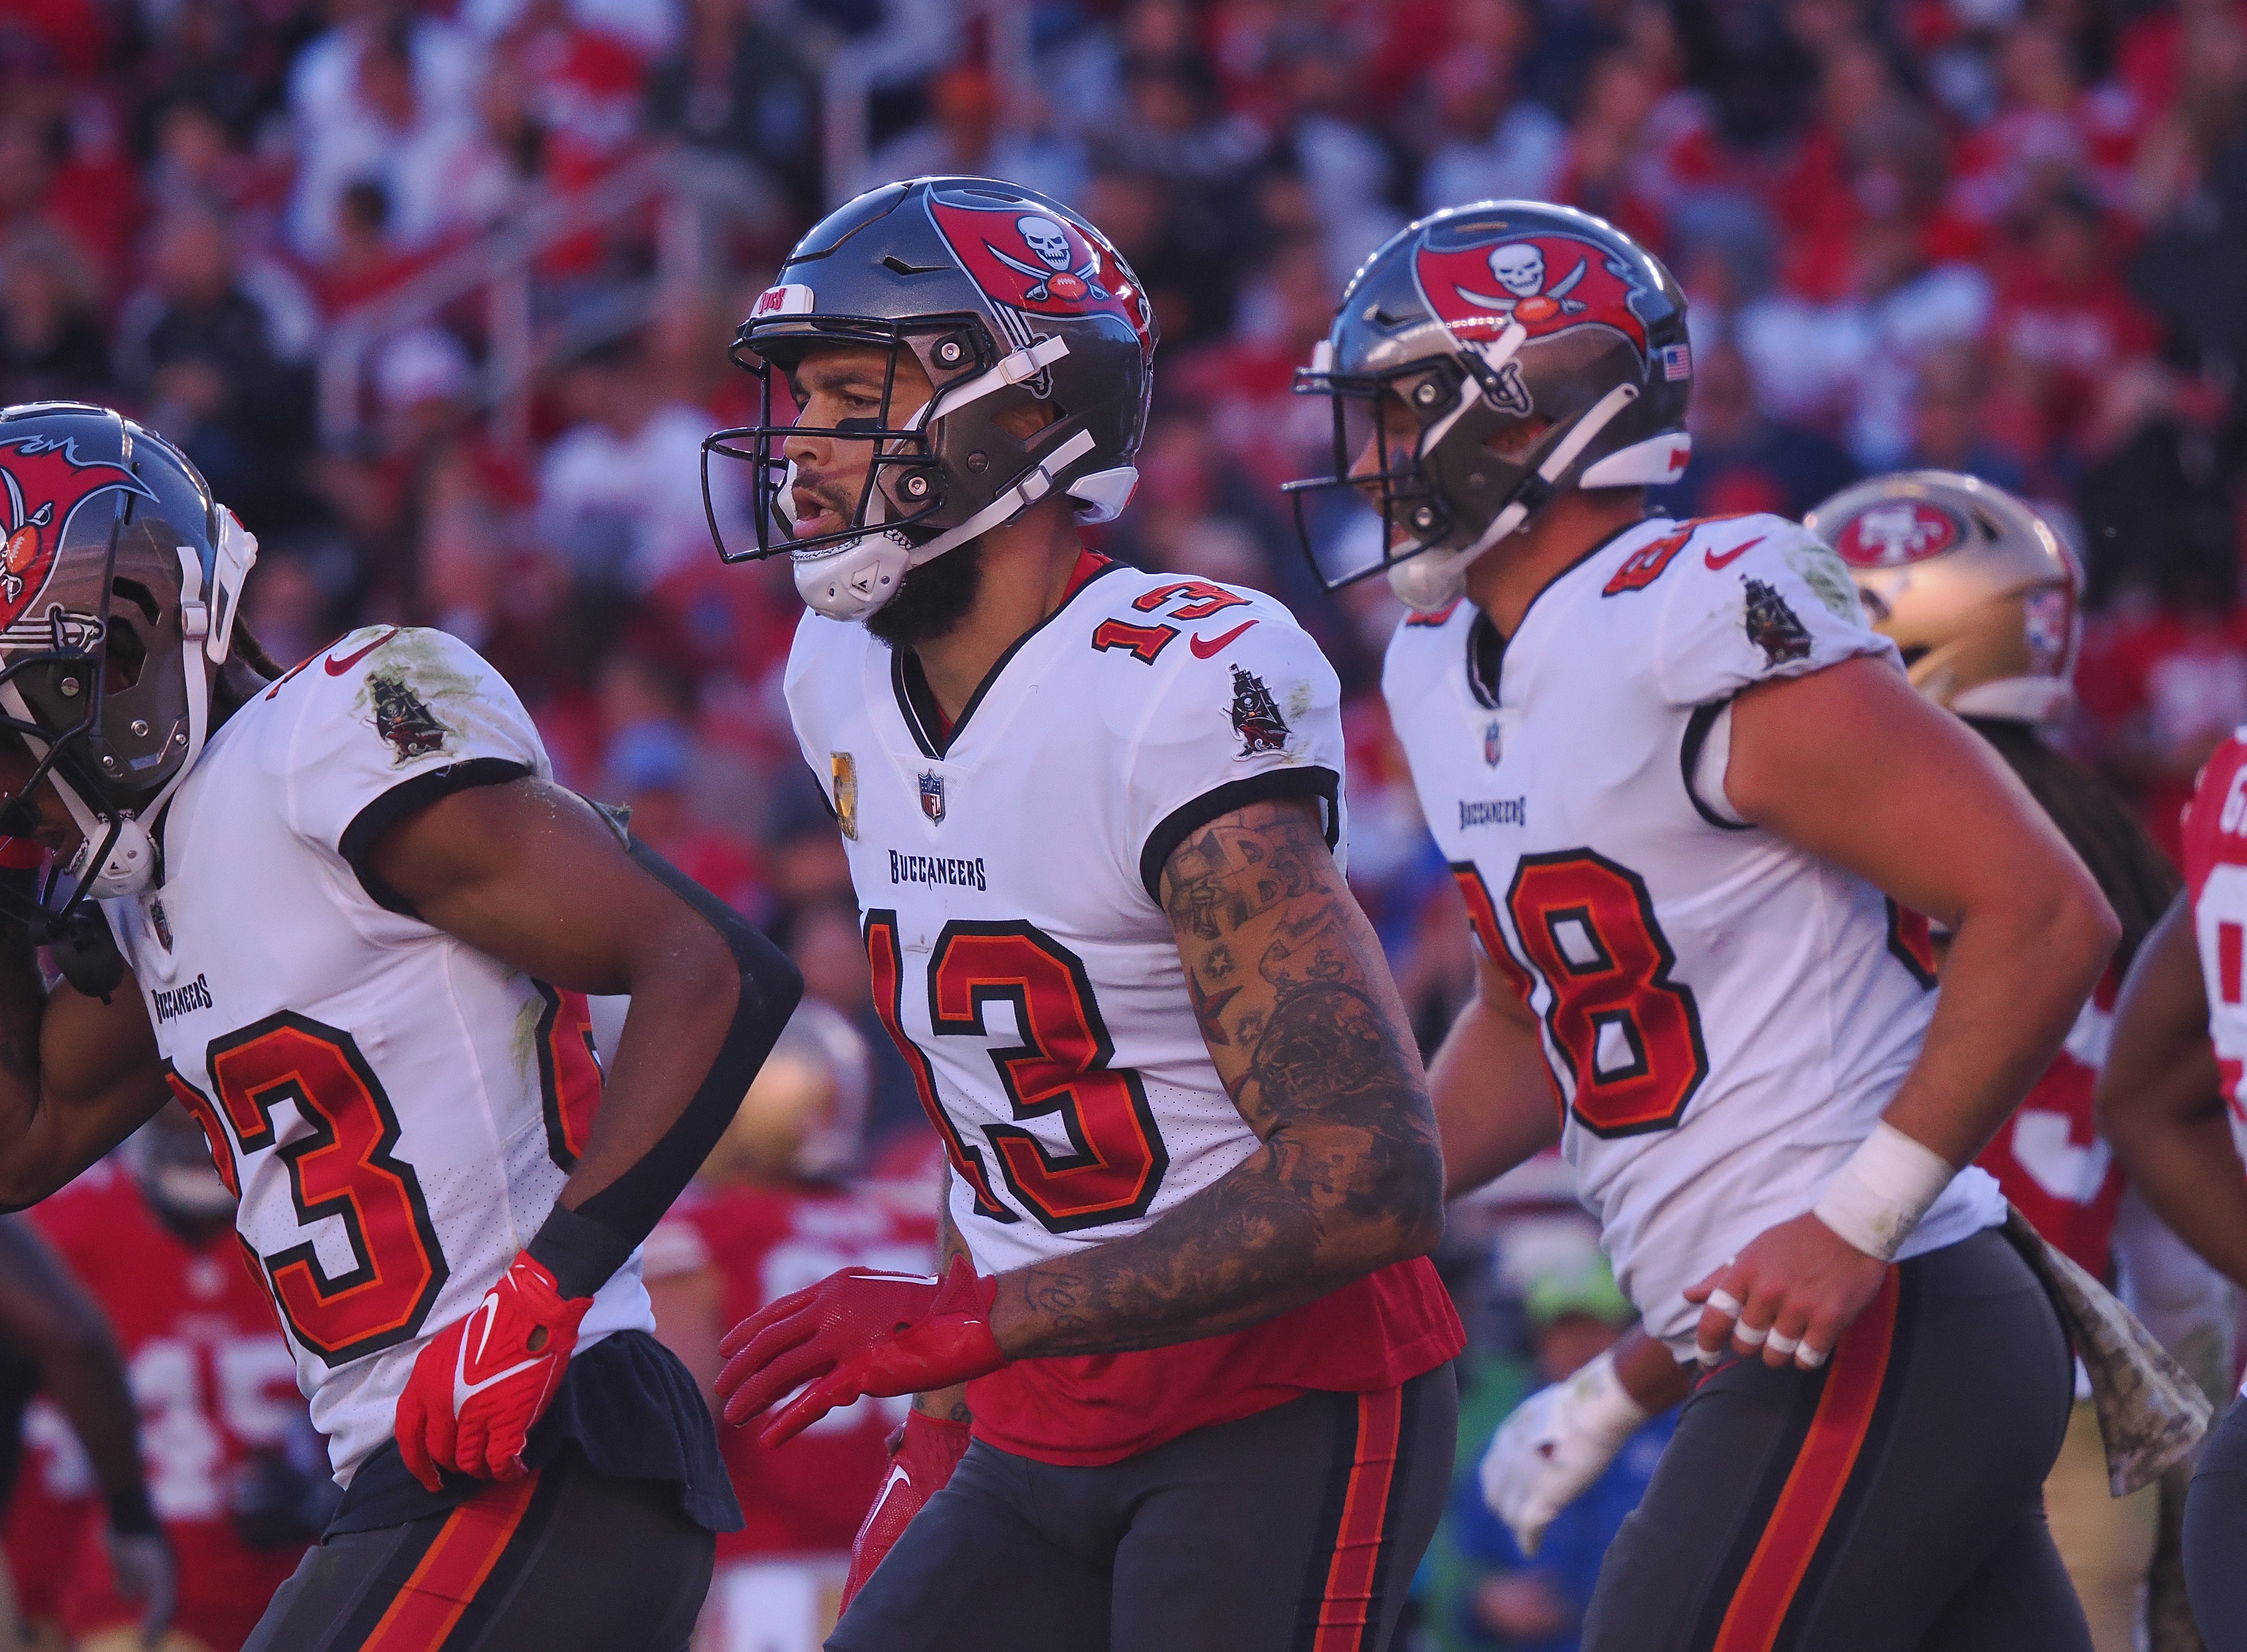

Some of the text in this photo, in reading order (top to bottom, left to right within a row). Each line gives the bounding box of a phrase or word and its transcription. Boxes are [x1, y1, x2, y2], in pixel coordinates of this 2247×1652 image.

[1091, 581, 1254, 666] 13
[888, 849, 986, 891] BUCCANEERS
[151, 973, 213, 1026] BUCCANEERS
[863, 908, 1170, 1234] 13
[161, 1009, 451, 1370] 3
